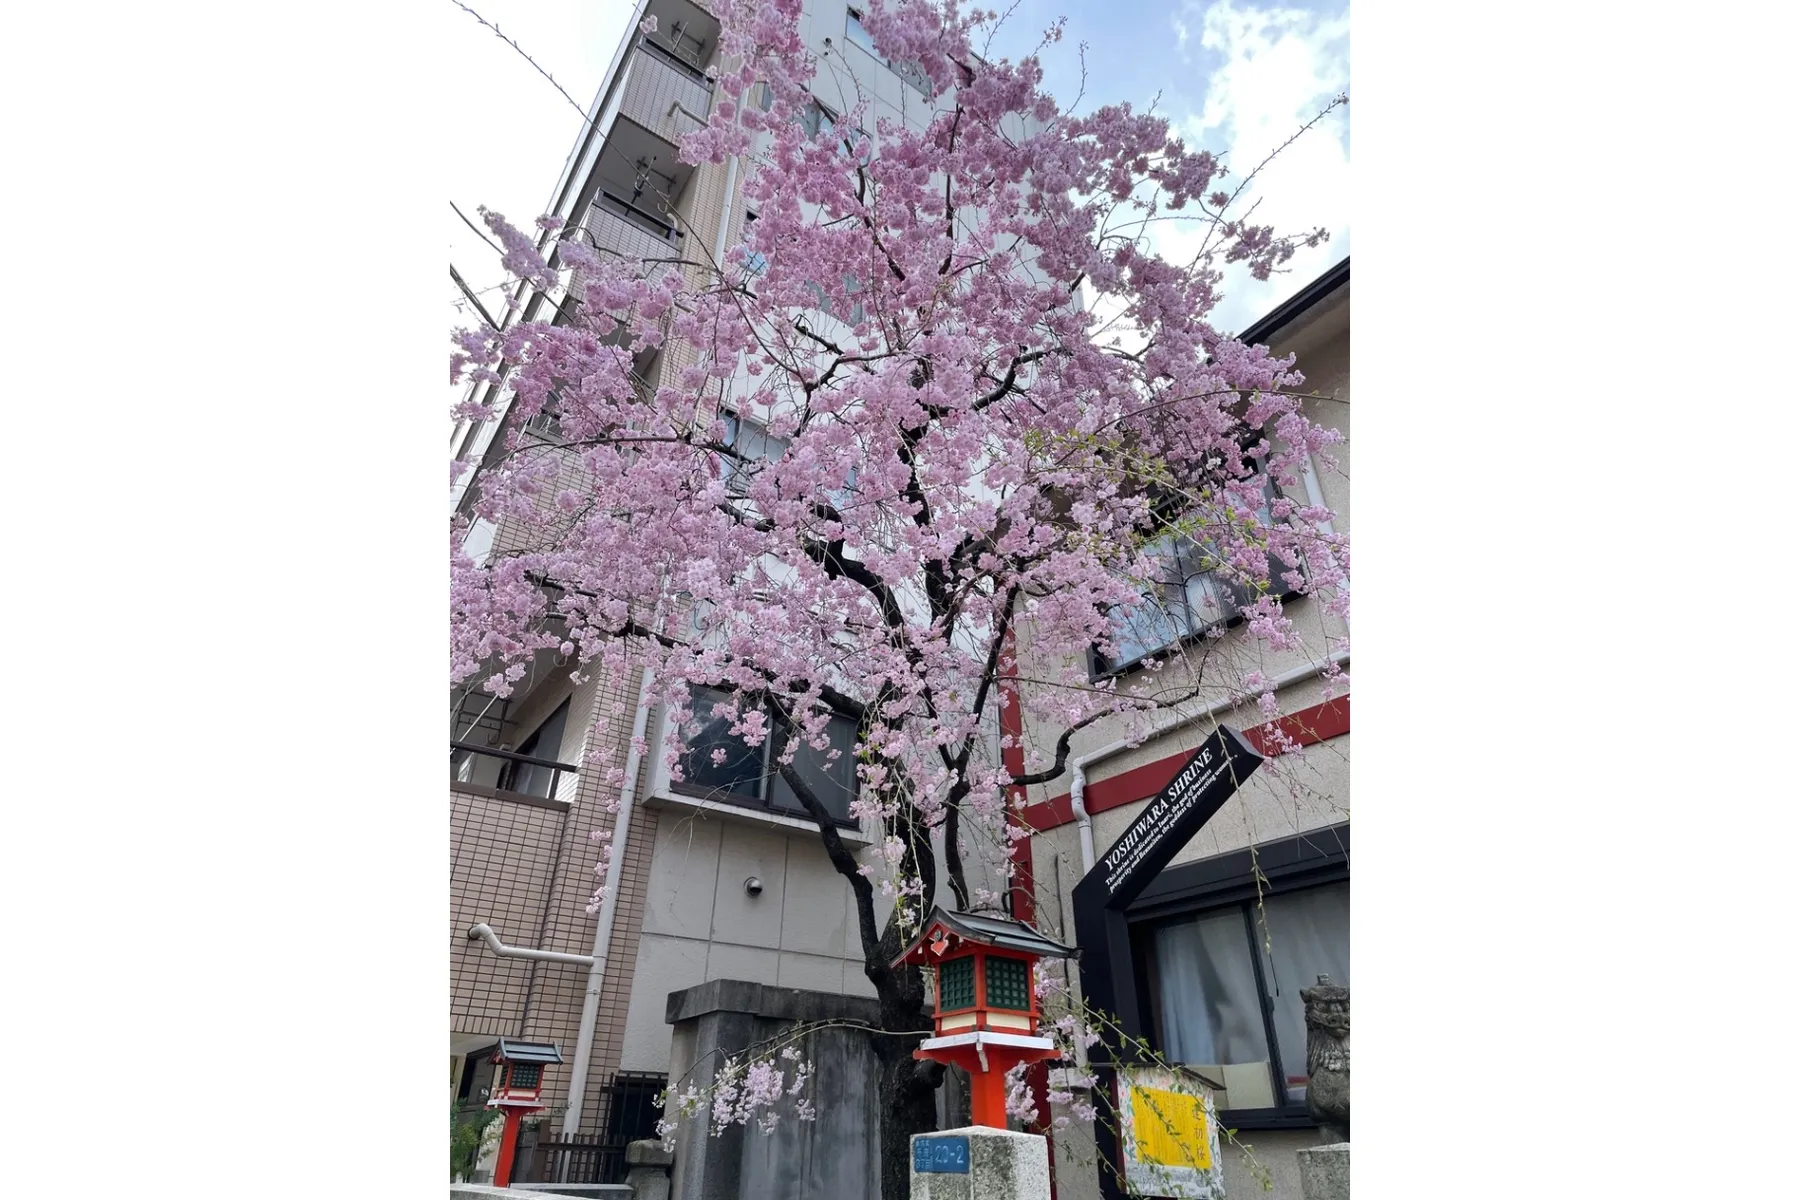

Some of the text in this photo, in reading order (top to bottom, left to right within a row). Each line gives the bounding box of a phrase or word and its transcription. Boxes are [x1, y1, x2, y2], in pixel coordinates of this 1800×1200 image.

[1190, 768, 1212, 791] business
[1187, 786, 1195, 797] of
[1189, 774, 1217, 803] protecting
[1178, 792, 1190, 807] god
[1185, 797, 1195, 808] of
[1104, 747, 1213, 871] YOSHIWARA SHRINE
[1169, 803, 1187, 828] goddess
[1171, 803, 1180, 814] the
[1153, 826, 1159, 834] to
[1161, 824, 1170, 834] the
[1133, 830, 1155, 856] dedicated
[1115, 858, 1130, 876] shrine
[1131, 855, 1140, 869] and
[1105, 873, 1116, 886] This
[1109, 866, 1132, 894] prosperity
[934, 1144, 964, 1164] 20-2
